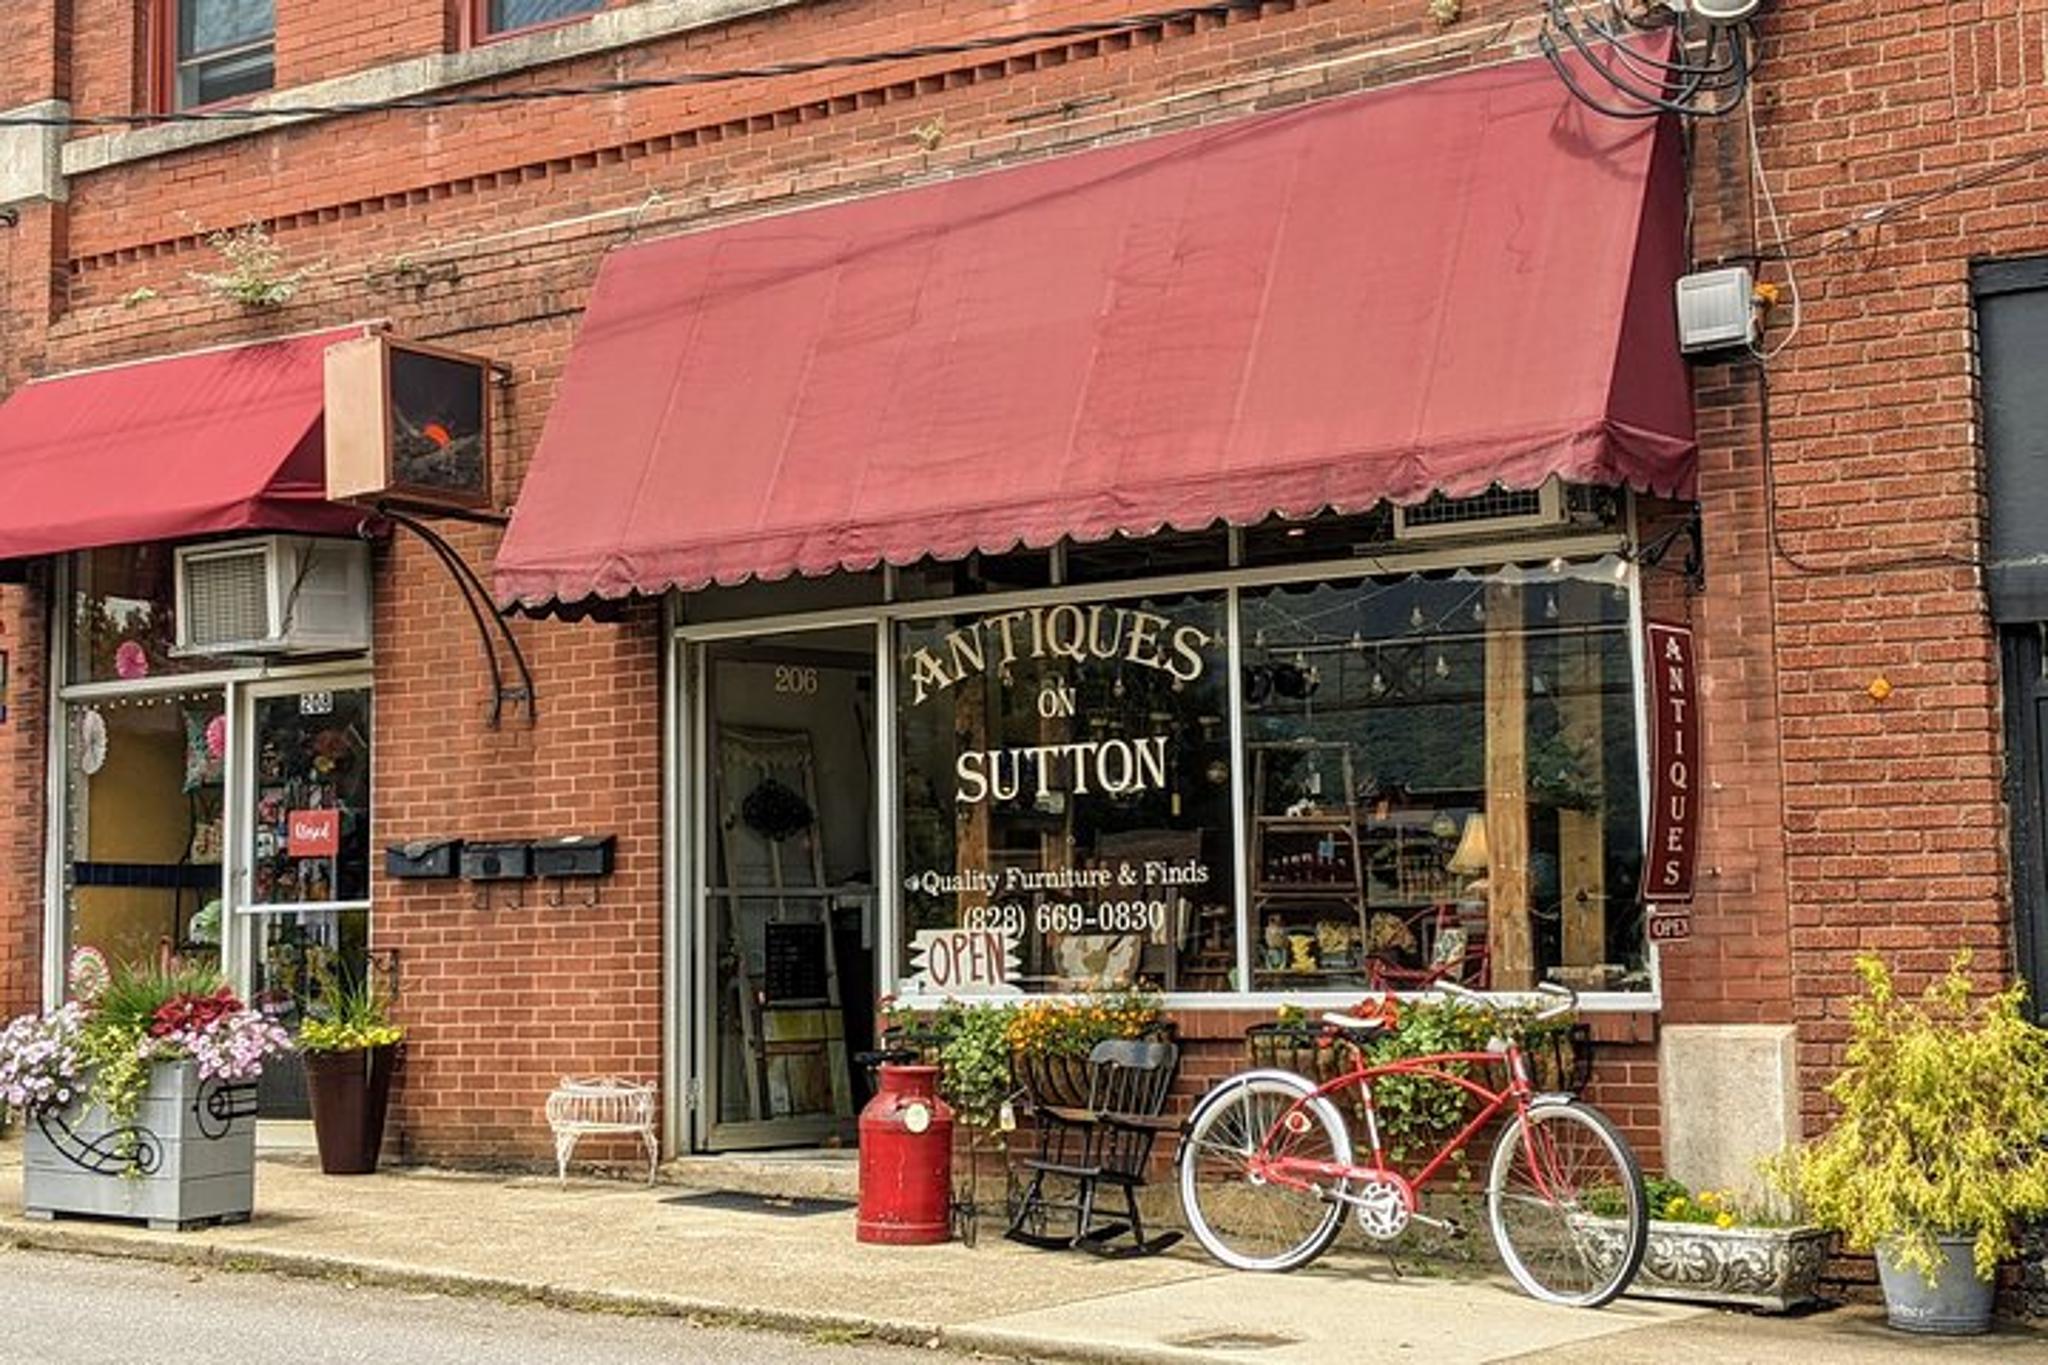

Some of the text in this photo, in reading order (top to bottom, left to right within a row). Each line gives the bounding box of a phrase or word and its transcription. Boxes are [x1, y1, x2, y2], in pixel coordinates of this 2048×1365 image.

[911, 605, 1210, 705] ANTIQUES
[775, 665, 818, 694] 206
[1037, 687, 1076, 718] ON
[955, 736, 1169, 803] SUTTON
[1664, 635, 1688, 886] ANTIQUES
[921, 859, 1209, 896] Quality Furniture & Finds
[963, 900, 1165, 939] (828) 669-0830
[928, 931, 1005, 986] OPEN
